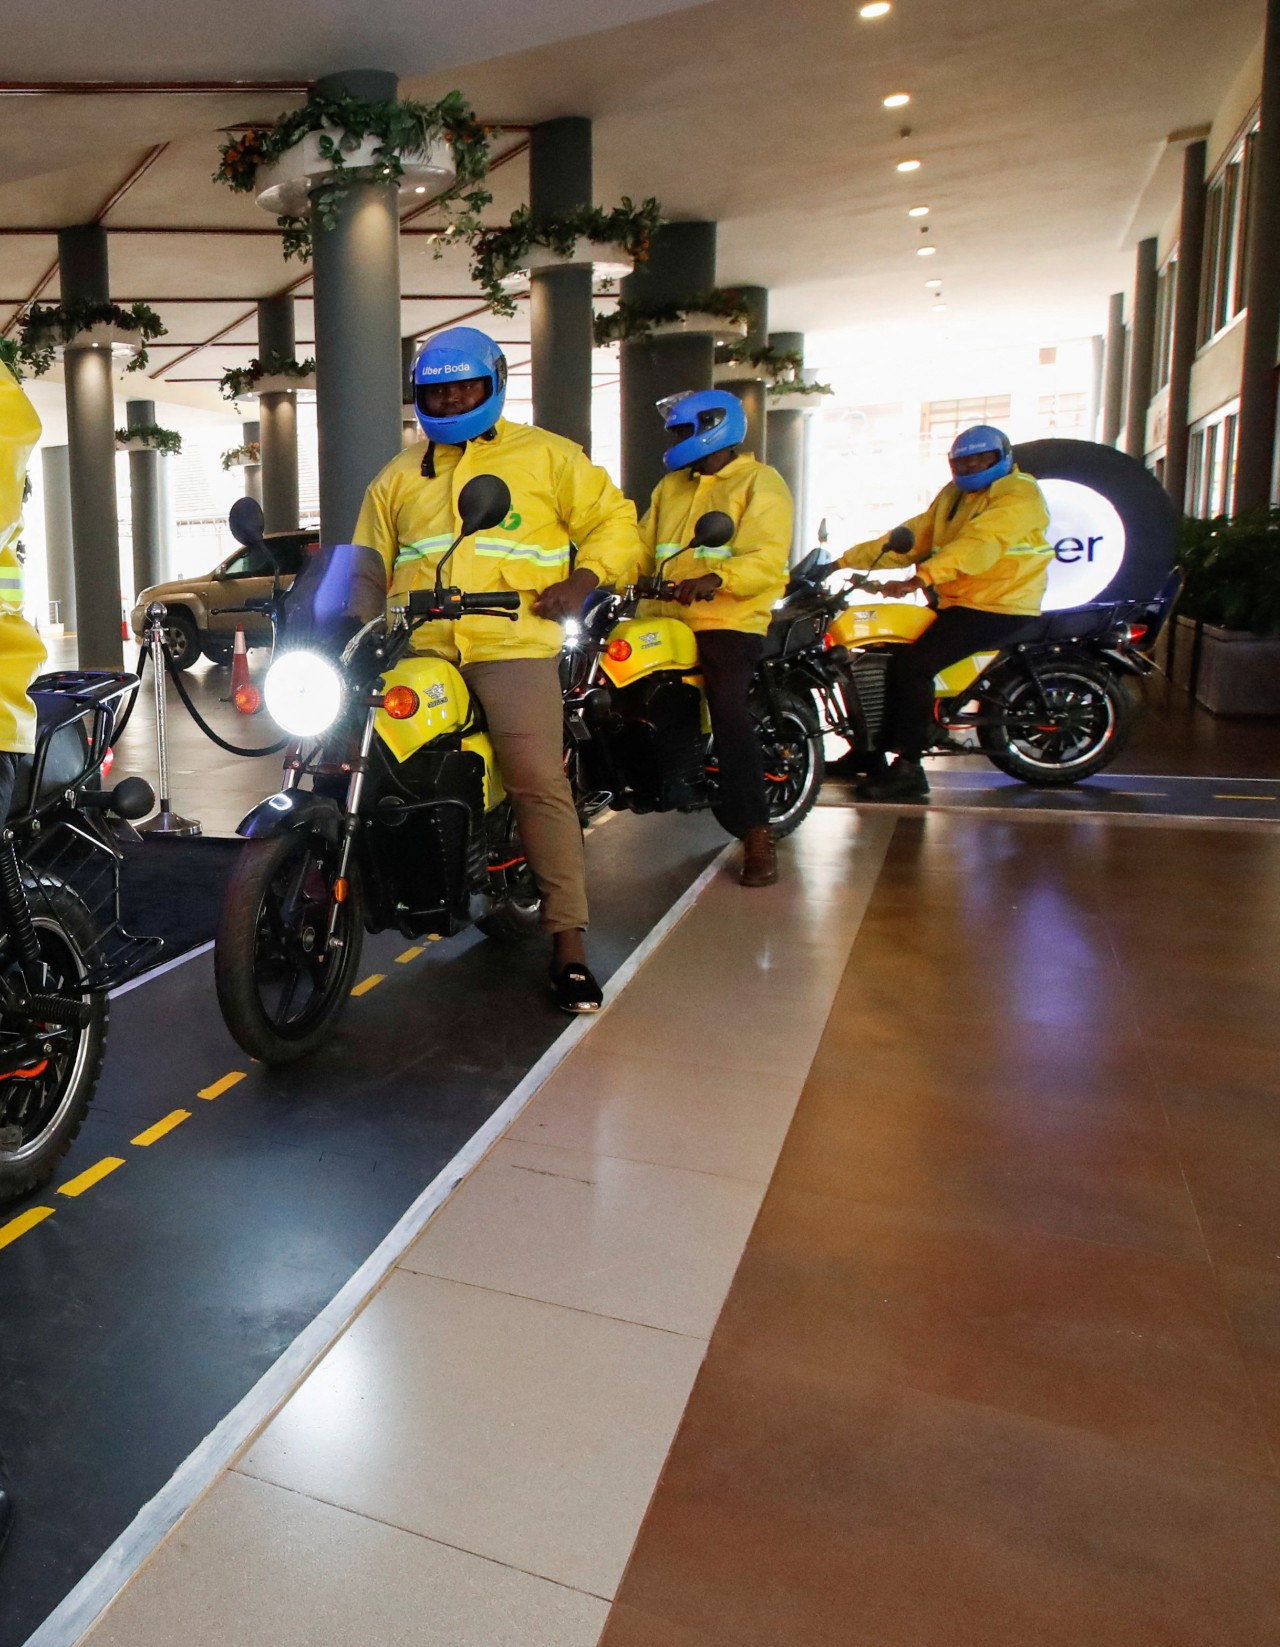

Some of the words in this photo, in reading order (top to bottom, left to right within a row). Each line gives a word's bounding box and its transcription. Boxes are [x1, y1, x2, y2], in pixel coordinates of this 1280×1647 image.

[422, 366, 442, 376] Uber
[444, 362, 470, 374] Boda
[1054, 536, 1103, 563] er
